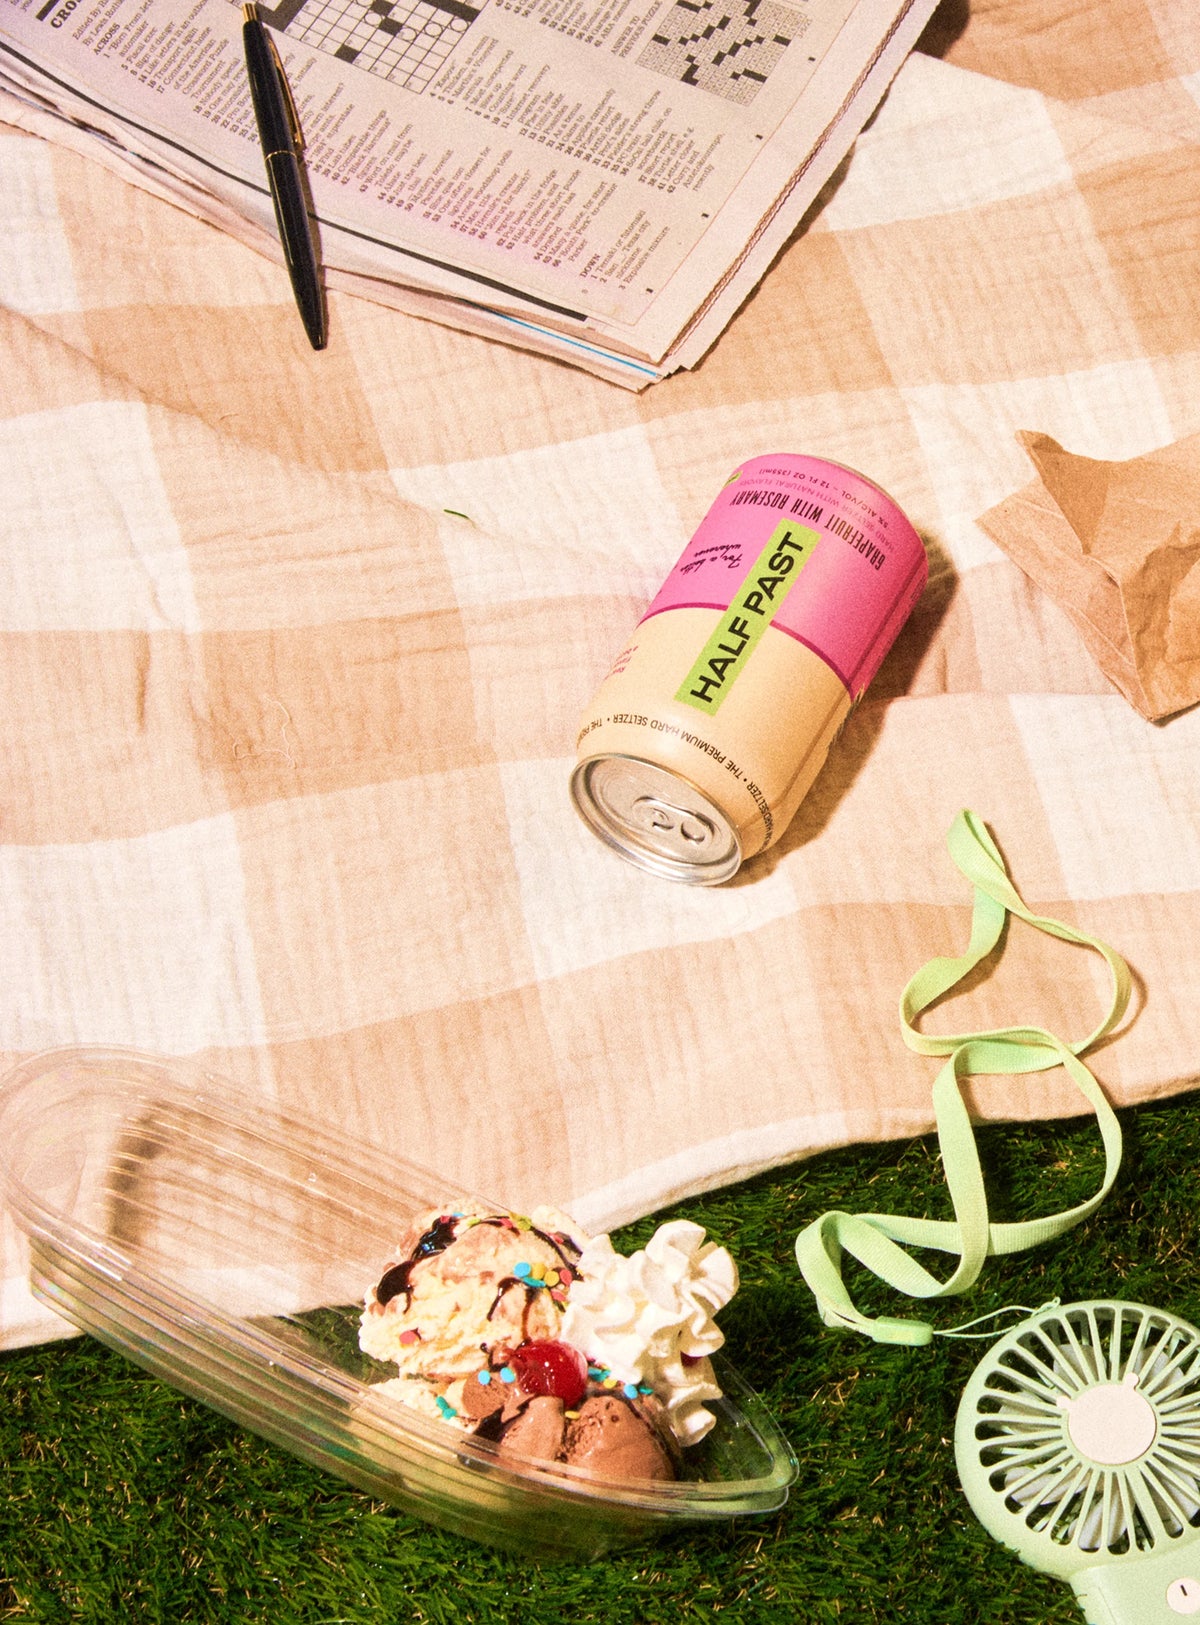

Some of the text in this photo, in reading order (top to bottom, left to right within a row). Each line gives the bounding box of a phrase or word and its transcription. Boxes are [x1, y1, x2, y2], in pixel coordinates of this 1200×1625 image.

[51, 0, 82, 28] CRO
[93, 23, 120, 54] ACROSS
[118, 20, 148, 57] automaker
[125, 42, 145, 63] Fiscal
[135, 21, 175, 69] Sign danger
[153, 27, 198, 79] Transport again
[473, 38, 499, 67] Vineyard
[611, 26, 633, 54] ANSWER
[144, 37, 177, 74] Like letters
[163, 26, 211, 85] Connecticut home
[182, 39, 229, 94] Crossword Puzzle
[188, 39, 216, 70] American
[190, 60, 225, 98] Tournament
[199, 57, 240, 105] Nobody special
[506, 64, 550, 119] Internet recovery
[488, 82, 514, 112] Counting
[517, 94, 540, 123] program
[564, 102, 581, 122] bonus
[628, 109, 648, 132] strong
[644, 90, 660, 108] throw
[572, 88, 615, 145] Applies carelessly
[614, 117, 629, 135] aides
[337, 109, 387, 172] Comparable things
[590, 112, 622, 153] Artful dodge
[624, 134, 641, 152] brain
[640, 133, 653, 146] ball
[364, 123, 413, 183] Word from
[637, 130, 667, 169] scoreboards
[644, 133, 677, 174] Short report
[662, 139, 694, 181] Letter closer
[404, 153, 427, 179] the best
[410, 149, 453, 202] Mystery novelist
[654, 156, 672, 177] Turtle
[672, 151, 699, 185] Curry and
[692, 164, 714, 191] recently
[438, 157, 483, 213] One often chosen
[473, 167, 500, 199] woodshop
[499, 173, 518, 197] creator
[512, 209, 527, 225] back
[539, 169, 557, 188] fridge
[535, 210, 551, 226] three
[549, 191, 565, 208] short
[562, 170, 581, 191] puzzle
[547, 183, 558, 196] and
[532, 221, 554, 247] answers
[563, 192, 575, 203] has
[539, 226, 562, 252] Drafted
[548, 237, 567, 255] Many
[568, 239, 587, 261] Parker
[623, 226, 670, 283] Explosive mixture
[579, 253, 600, 277] DOWN
[616, 247, 641, 279] nickname
[793, 471, 806, 480] OZ
[809, 475, 819, 485] FL
[820, 480, 830, 489] 12
[841, 490, 877, 518] ALC/VOL
[729, 490, 886, 571] GRAPEFRUIT WITH ROSEMARY
[720, 553, 743, 569] For
[690, 531, 804, 703] HALF PAST
[589, 717, 603, 731] THE
[612, 713, 649, 727] SELTZER
[650, 719, 681, 737] HARD
[680, 731, 727, 764] PREMIUM
[724, 759, 744, 780] THE
[746, 781, 769, 813] SELTZER
